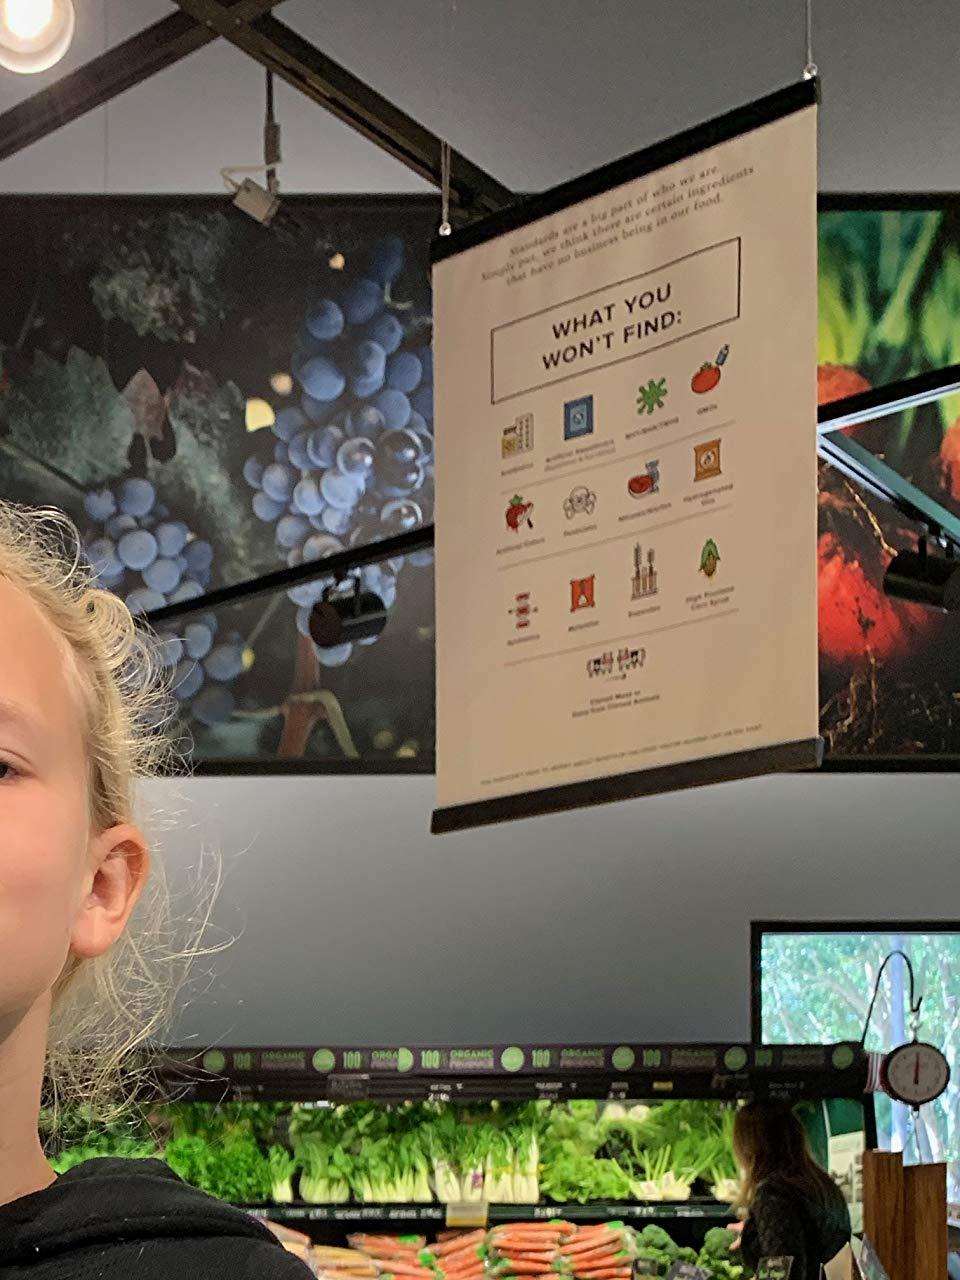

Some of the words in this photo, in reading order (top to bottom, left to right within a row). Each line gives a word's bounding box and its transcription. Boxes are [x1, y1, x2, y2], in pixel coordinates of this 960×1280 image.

[509, 231, 559, 256] Standards
[611, 199, 633, 218] part
[560, 231, 589, 250] think
[593, 219, 621, 237] there
[644, 194, 685, 217] certain
[688, 167, 754, 198] ingredients
[574, 235, 619, 259] business
[622, 223, 653, 240] being
[551, 303, 616, 340] WHAT
[624, 276, 672, 315] YOU
[542, 331, 615, 370] WON'T
[623, 310, 683, 344] FIND:
